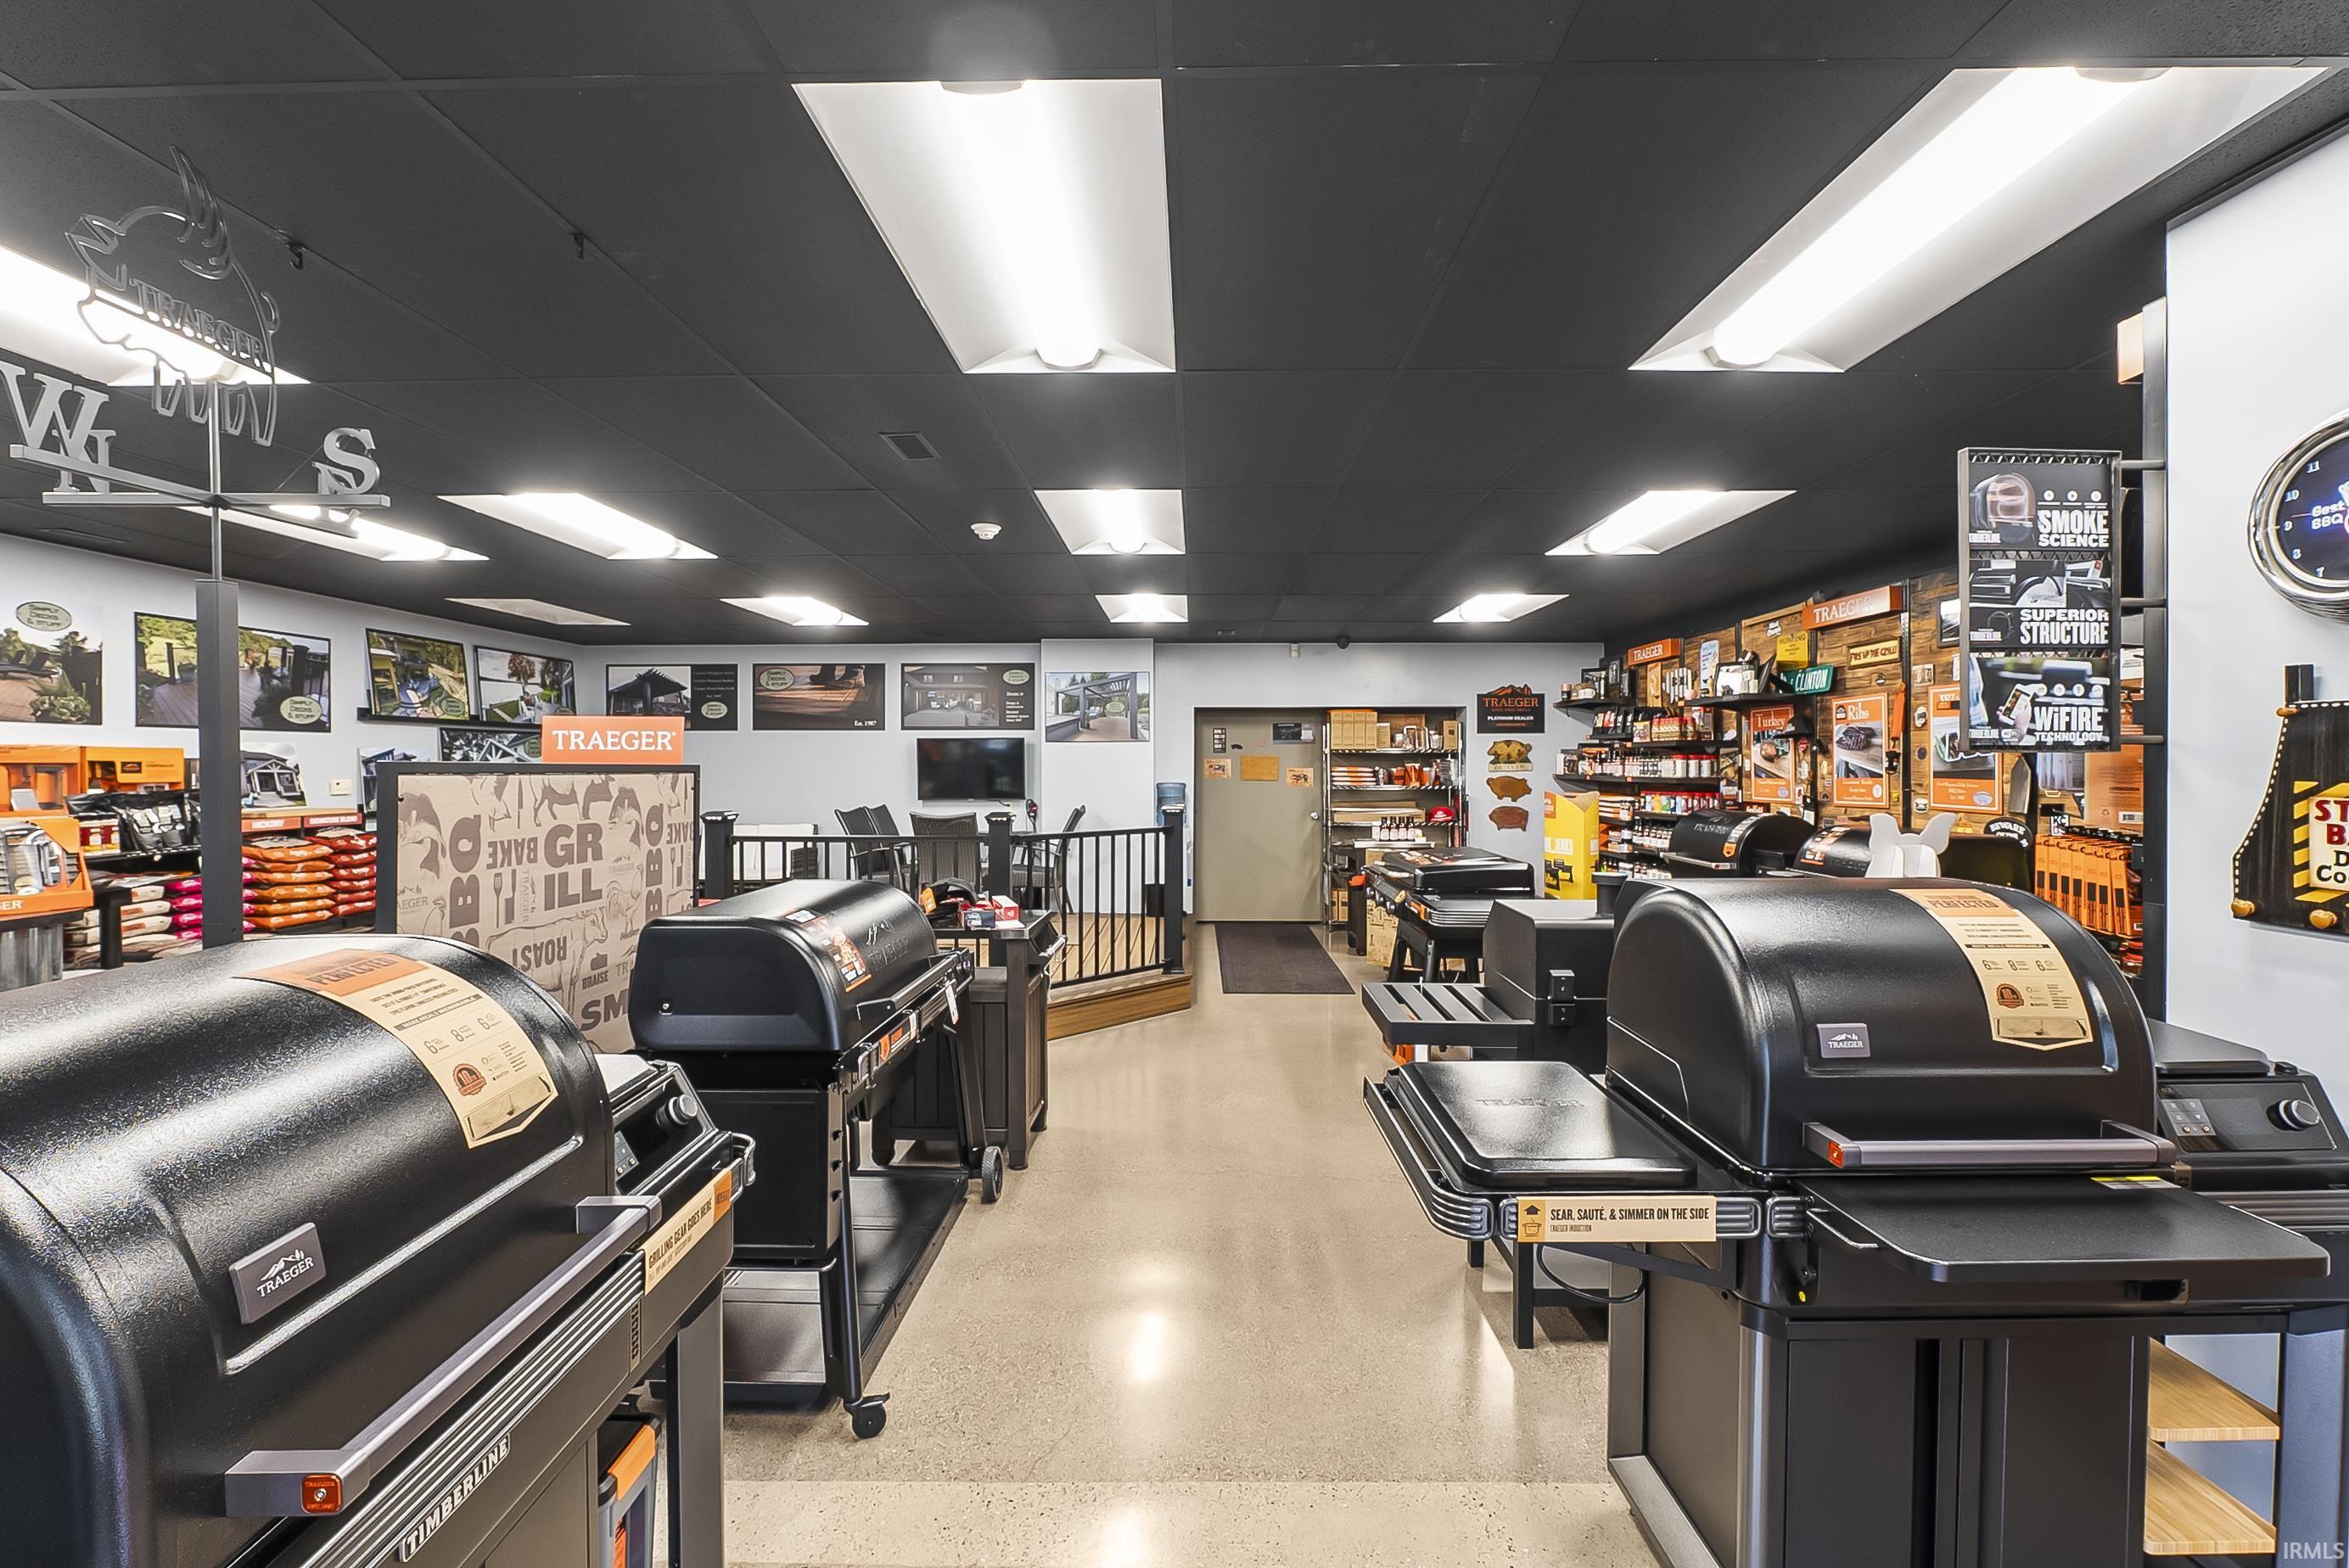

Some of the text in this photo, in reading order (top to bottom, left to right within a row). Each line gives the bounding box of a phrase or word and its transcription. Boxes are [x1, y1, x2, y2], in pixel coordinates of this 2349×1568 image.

[323, 427, 380, 496] S
[2307, 461, 2320, 473] 11
[2285, 490, 2299, 501] 10
[2311, 500, 2346, 517] Best
[2038, 510, 2109, 535] SMOKE
[2283, 521, 2293, 531] 9
[2312, 513, 2344, 529] BBQ
[2038, 534, 2110, 547] SCIENCE
[2315, 567, 2324, 578] 7
[1814, 596, 1875, 624] TRAEGER
[2020, 608, 2110, 621] SUPERIOR
[2020, 622, 2110, 645] STRUCTURE
[1633, 644, 1663, 662] TRAEGER
[1795, 669, 1829, 692] CLINTON
[1483, 697, 1539, 707] TRAEGER
[1848, 702, 1870, 720] Ribs
[1756, 713, 1786, 729] Turkey
[2034, 707, 2104, 731] WiFIRE
[552, 730, 673, 751] TRAEGER
[2034, 732, 2103, 742] TECHNOLOGY
[486, 837, 538, 870] BAKE
[544, 822, 603, 869] GR
[544, 868, 603, 912] ILL
[1926, 900, 1999, 909] PERFECTED
[306, 957, 399, 986] PERFECTED
[582, 971, 609, 990] BRAISE
[1827, 1040, 1864, 1049] TRAEGER
[1550, 1206, 1710, 1222] SEAR, SAUTÉ, & SIMMER ON THE SIDE
[648, 1235, 674, 1269] GRILLING
[674, 1224, 687, 1246] GEAR
[687, 1210, 700, 1231] GOES
[700, 1197, 713, 1219] HERE
[257, 1257, 315, 1297] TRAEGER
[407, 1437, 508, 1555] TIMBERLINE
